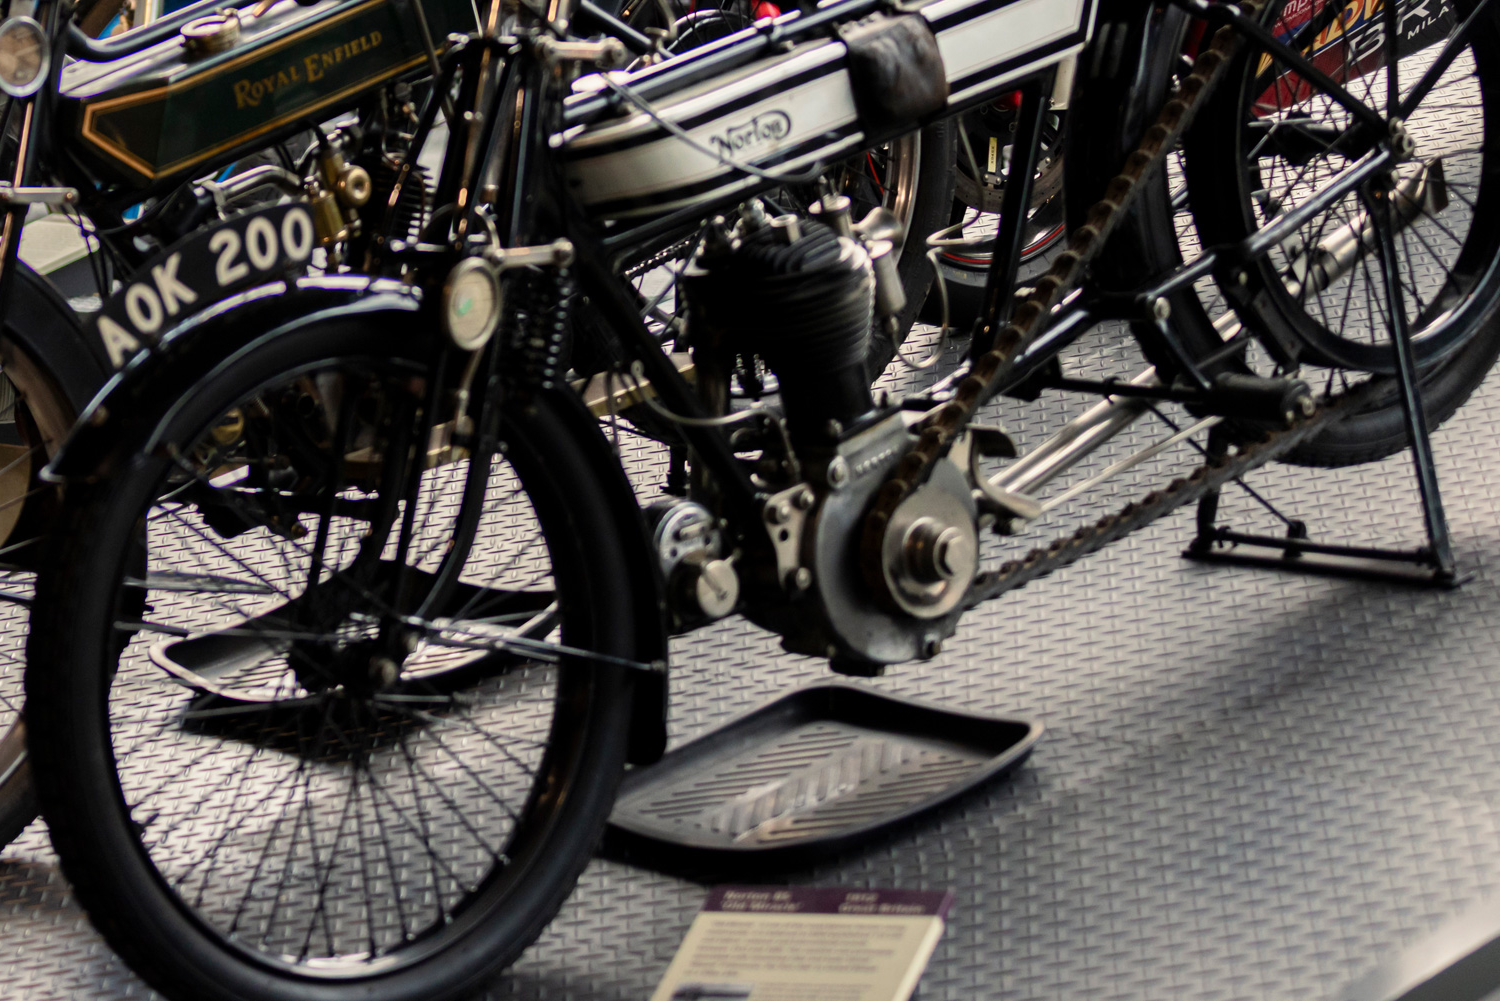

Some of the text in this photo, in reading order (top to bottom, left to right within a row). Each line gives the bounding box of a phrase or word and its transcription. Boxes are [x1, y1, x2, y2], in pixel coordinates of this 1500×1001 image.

[233, 30, 383, 110] ROYAL ENFIELD
[710, 110, 791, 158] Norton
[97, 207, 315, 369] AOK 200
